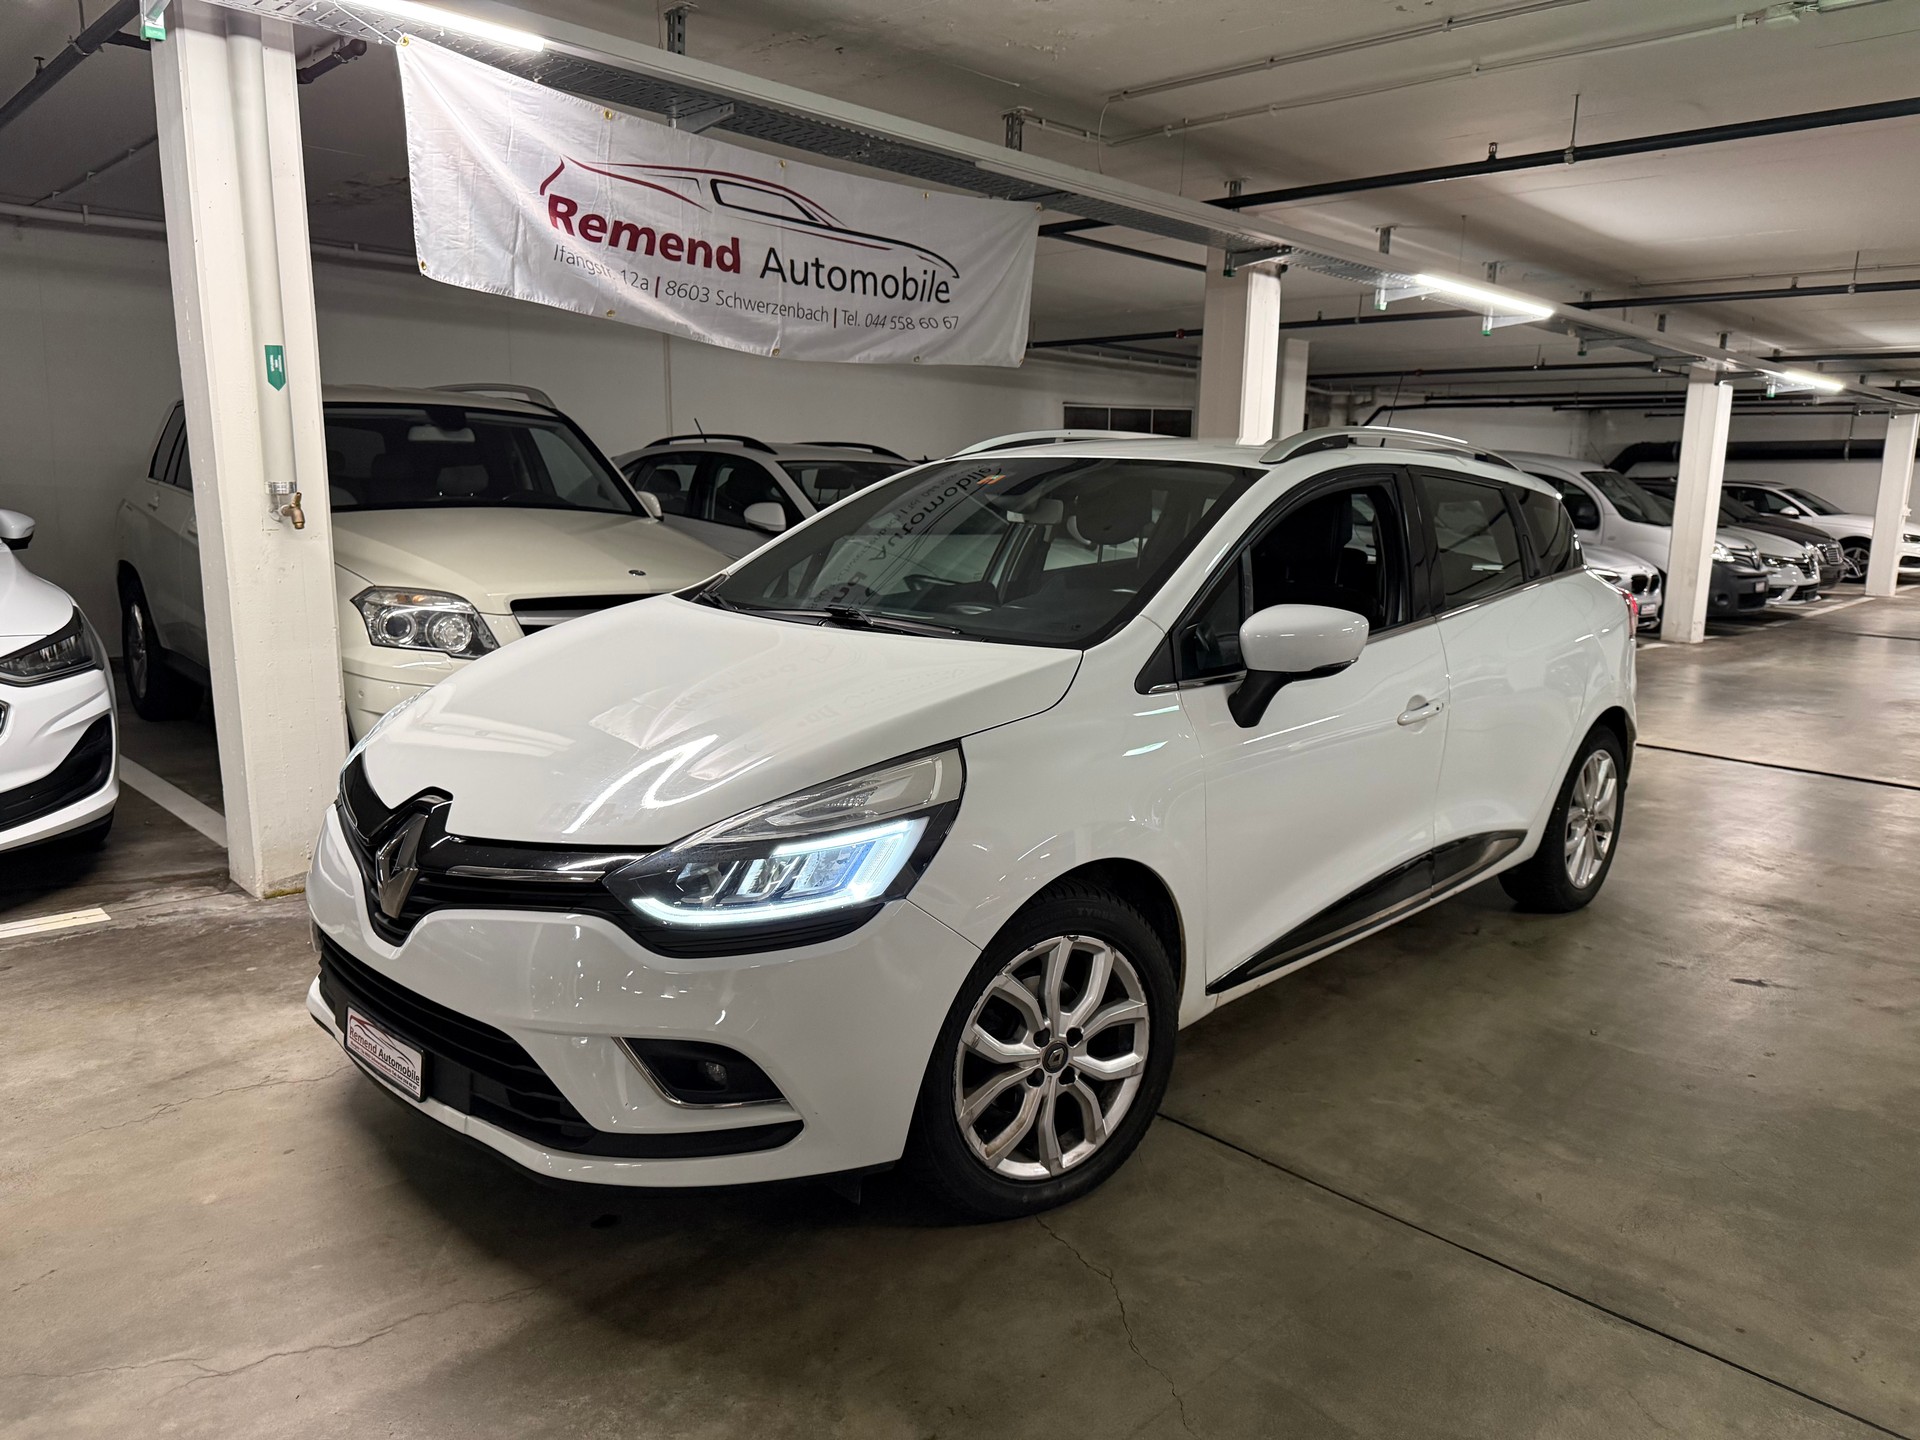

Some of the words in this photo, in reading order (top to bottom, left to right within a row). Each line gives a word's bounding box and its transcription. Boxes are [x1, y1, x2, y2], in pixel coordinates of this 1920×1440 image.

[548, 193, 741, 274] Remend
[759, 247, 951, 304] Automobile
[620, 269, 649, 290] 12a
[665, 280, 710, 302] 8603
[716, 289, 829, 323] Schwerzenbach
[841, 309, 860, 327] Tel.
[865, 313, 887, 329] 044
[890, 315, 916, 330] 558
[919, 316, 939, 330] 60
[943, 315, 959, 330] 67
[349, 1026, 378, 1054] Remend
[378, 1048, 420, 1084] Automobile
